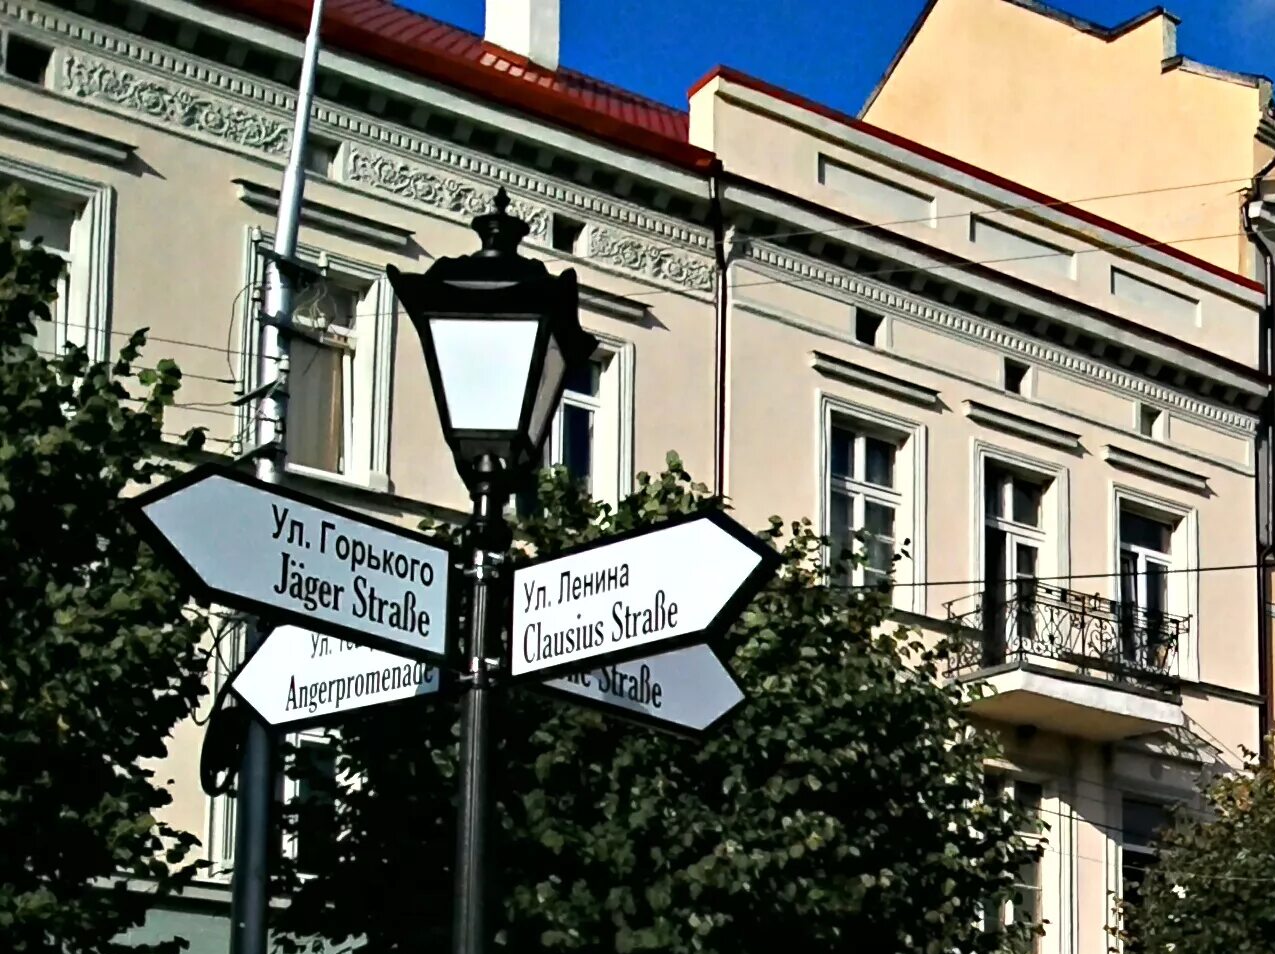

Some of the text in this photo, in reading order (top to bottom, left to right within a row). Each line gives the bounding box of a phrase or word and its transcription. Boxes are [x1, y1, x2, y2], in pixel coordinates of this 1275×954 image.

[271, 504, 434, 587] Ул. Горького
[274, 552, 431, 637] Jäger Straße
[523, 589, 679, 664] Clausius Straße
[524, 563, 630, 613] Ул. Ленина
